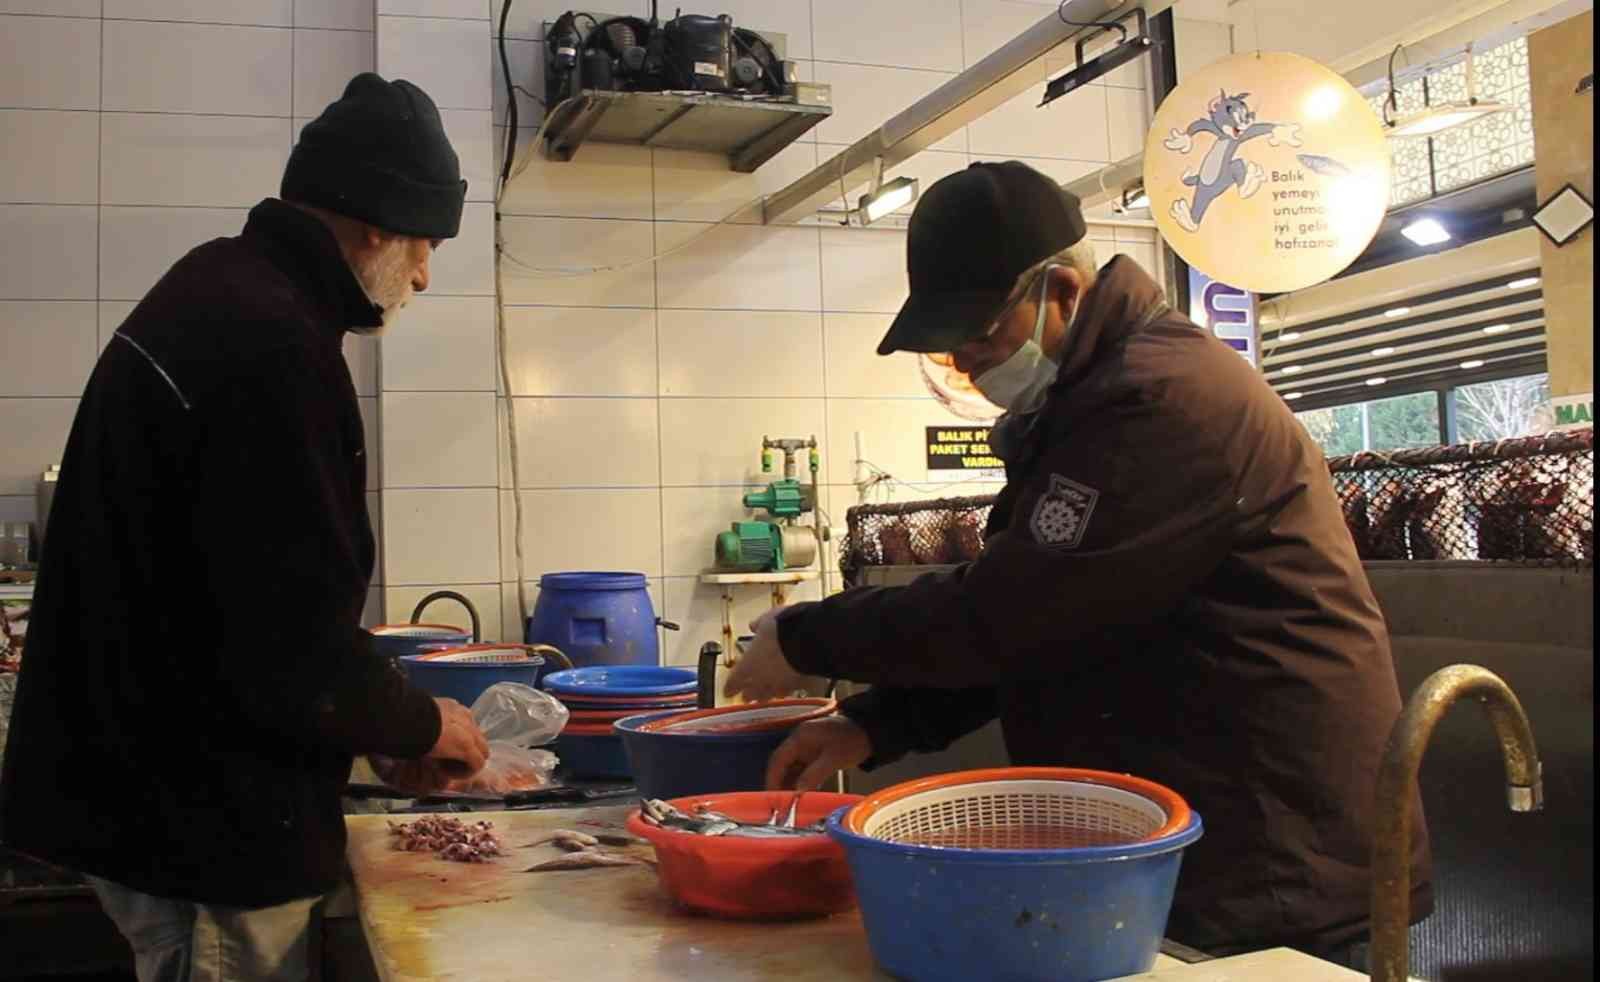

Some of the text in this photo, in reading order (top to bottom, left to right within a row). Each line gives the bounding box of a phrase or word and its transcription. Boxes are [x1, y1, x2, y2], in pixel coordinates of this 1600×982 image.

[1271, 170, 1305, 182] Balık
[1274, 221, 1290, 235] iyi
[1555, 401, 1593, 426] MA
[937, 431, 973, 442] BALIK
[930, 444, 967, 455] PAKET
